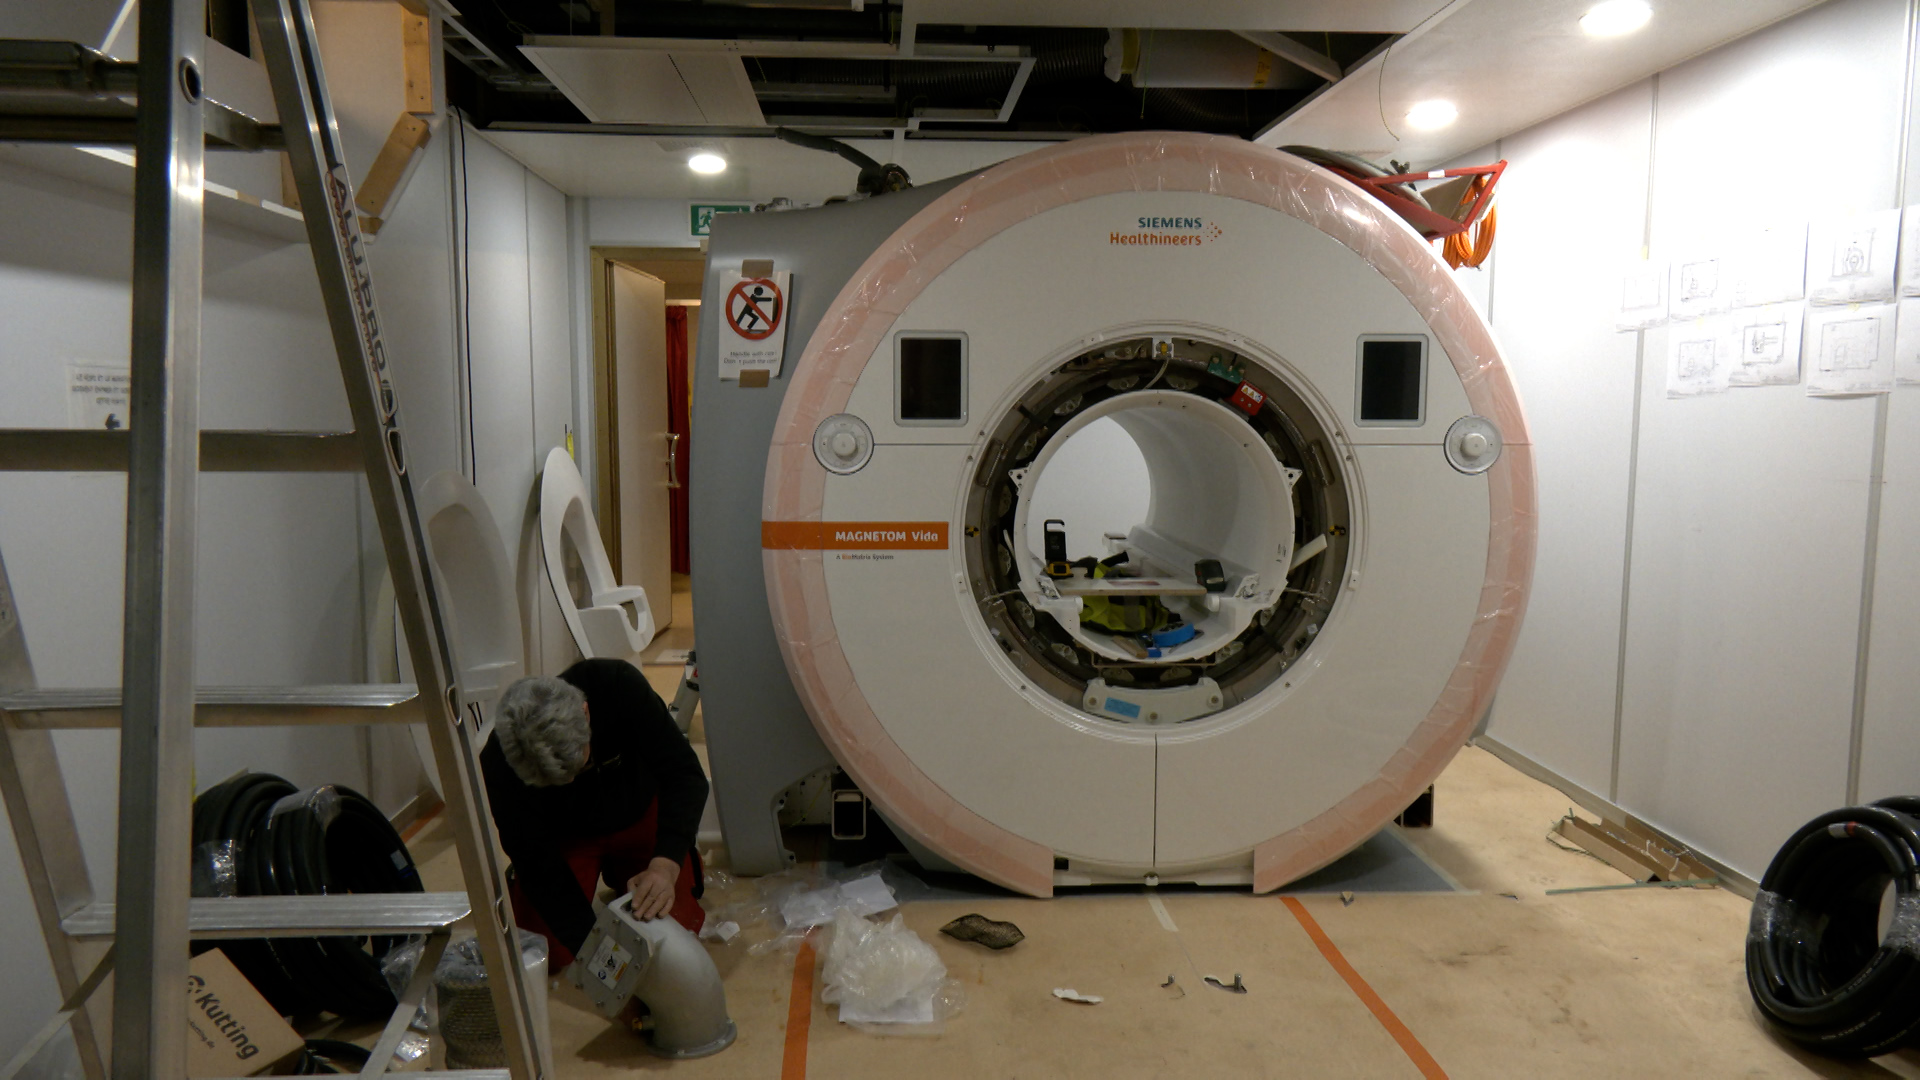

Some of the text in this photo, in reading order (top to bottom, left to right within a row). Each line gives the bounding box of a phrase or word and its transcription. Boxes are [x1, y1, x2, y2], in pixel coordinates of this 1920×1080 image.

[1137, 216, 1202, 229] SIEMENS
[1109, 231, 1202, 246] Healthineers
[835, 529, 939, 542] MAGNETOM Vida
[195, 992, 260, 1060] Kutting
